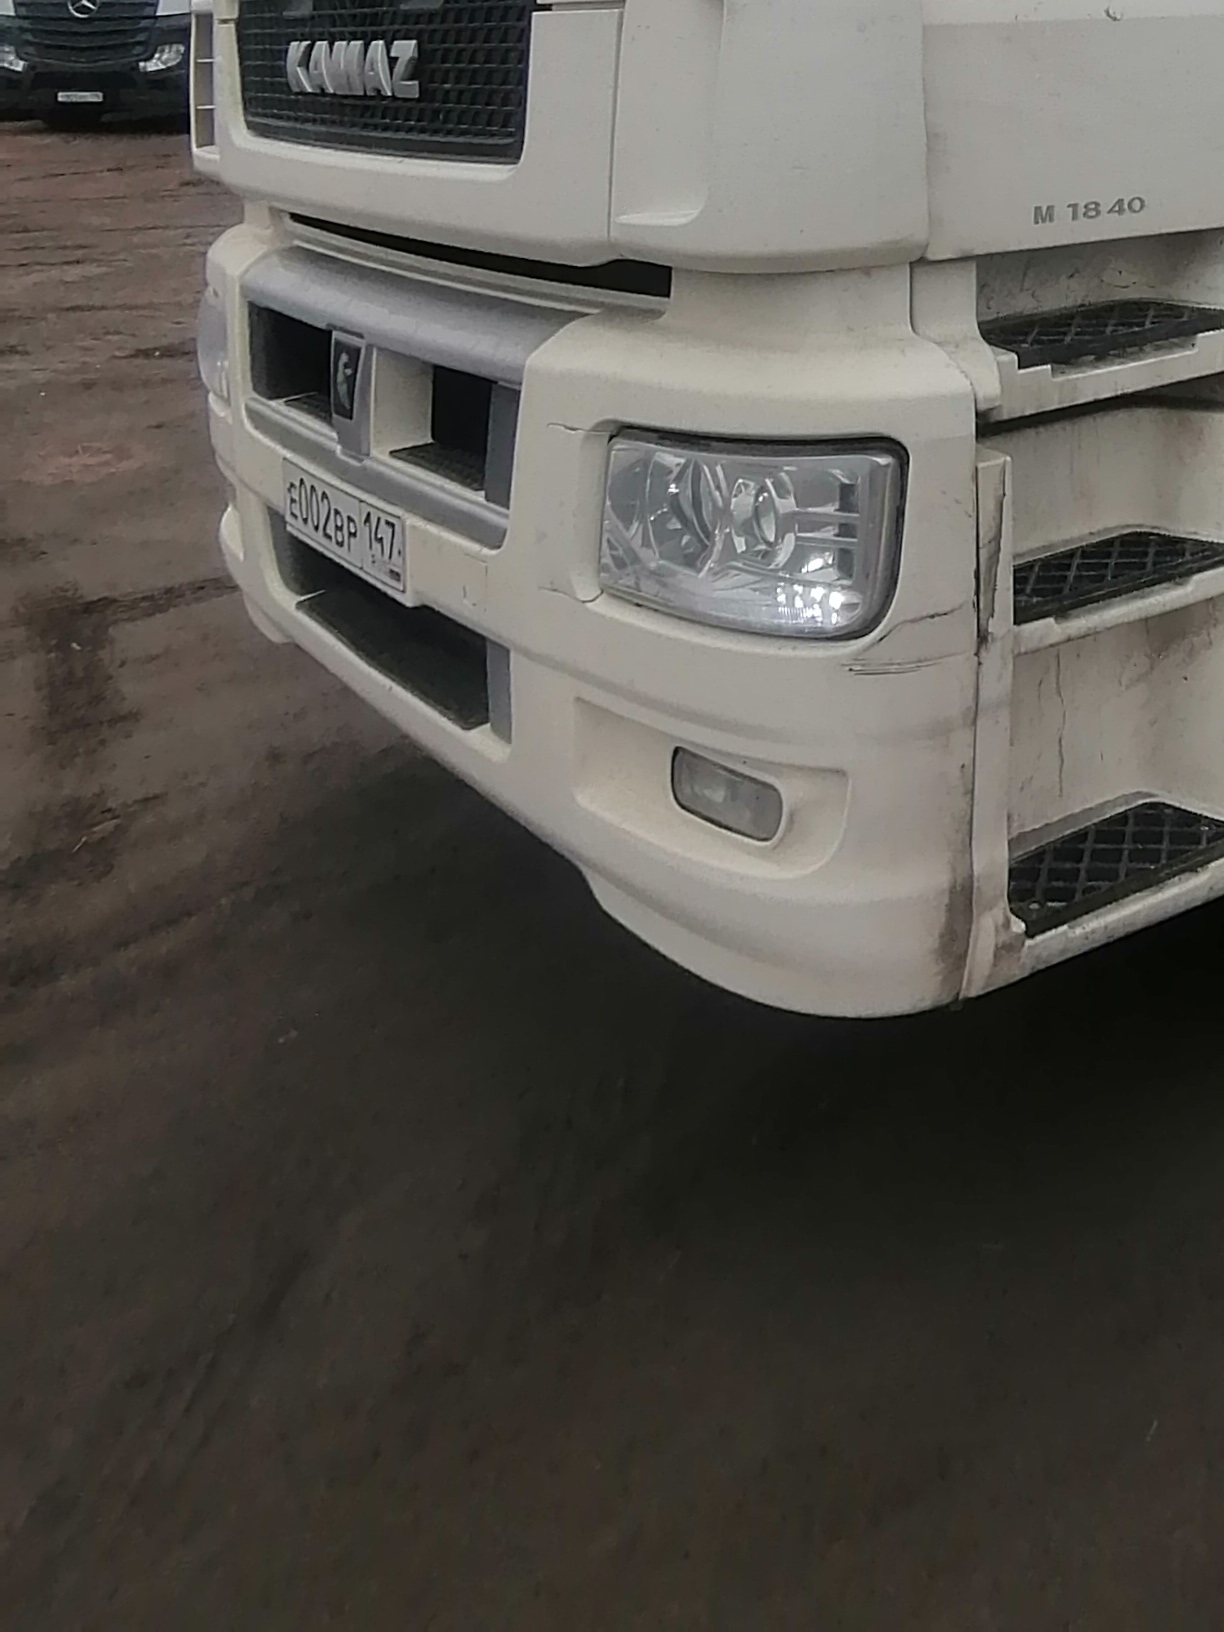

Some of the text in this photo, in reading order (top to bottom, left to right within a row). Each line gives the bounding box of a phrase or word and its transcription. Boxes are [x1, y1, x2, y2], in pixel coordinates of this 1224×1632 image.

[286, 39, 420, 99] KAMAZ
[1032, 204, 1056, 226] M
[363, 510, 397, 561] 147
